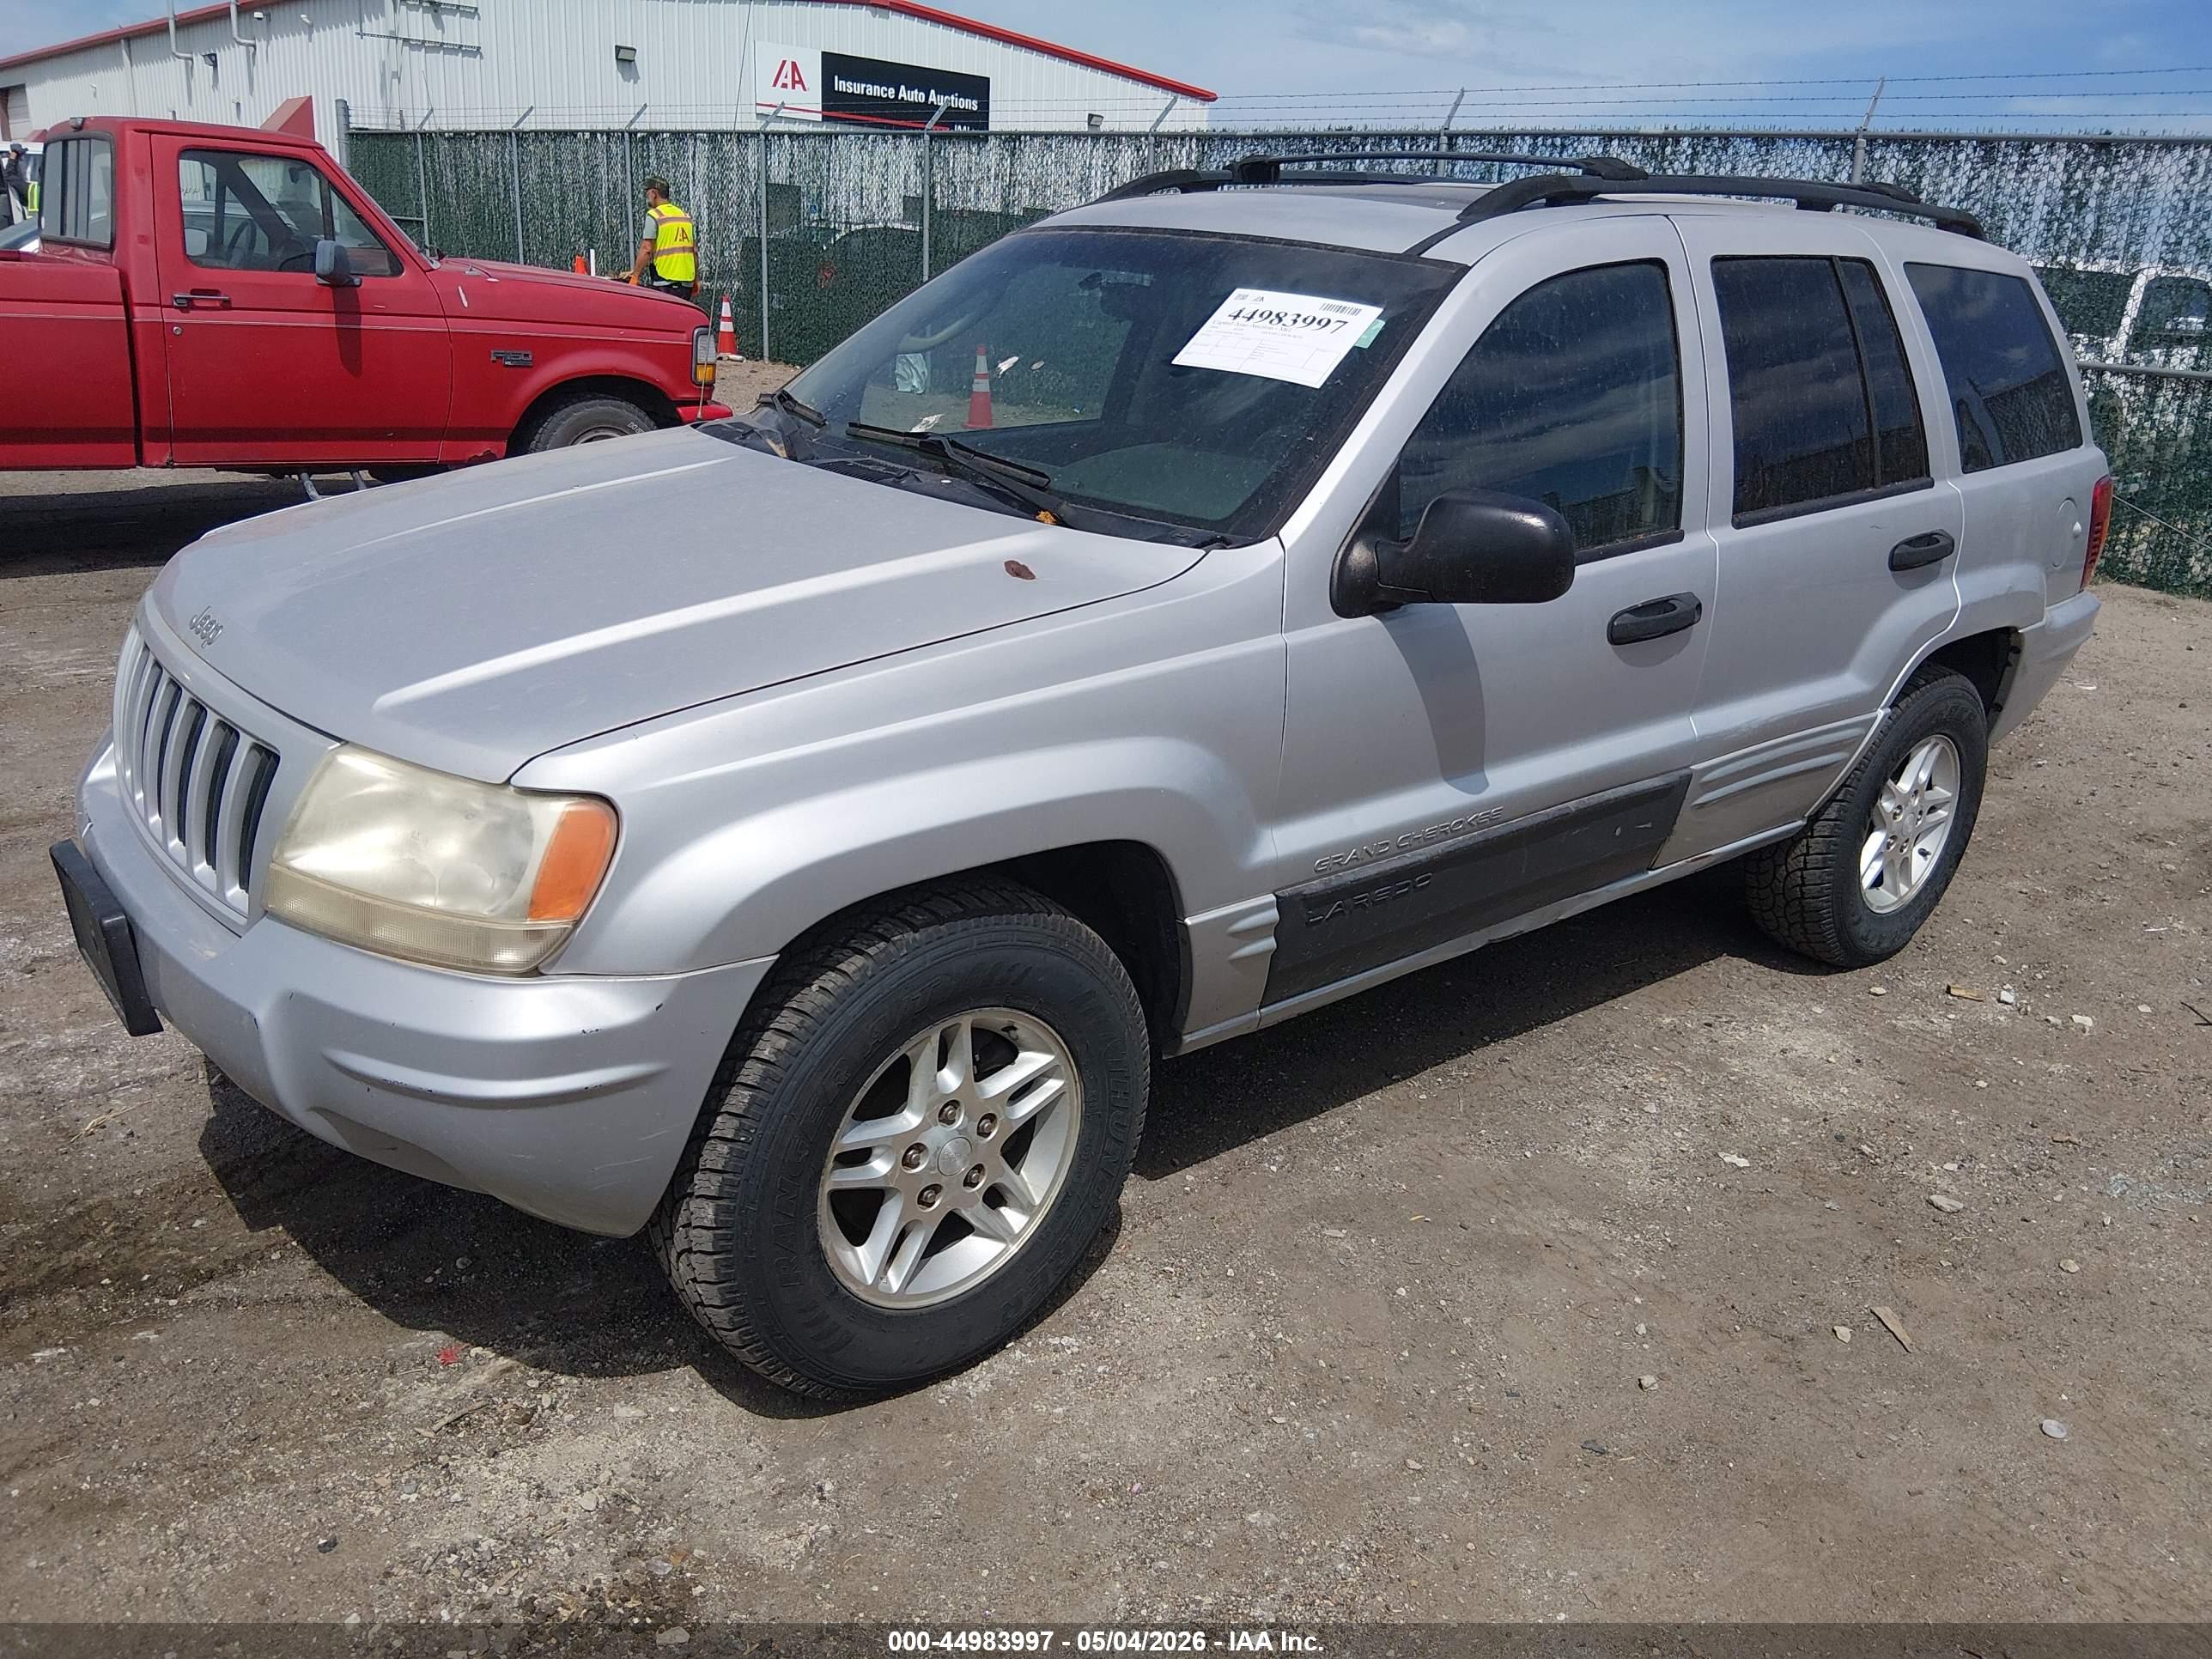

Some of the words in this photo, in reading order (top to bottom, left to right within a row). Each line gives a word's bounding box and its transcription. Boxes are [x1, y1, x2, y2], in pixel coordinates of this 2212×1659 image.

[834, 75, 895, 99] Insurance
[898, 85, 925, 103] Auto
[927, 89, 978, 111] Auctions
[1228, 307, 1348, 334] 44983997
[189, 605, 224, 649] Jeep
[1313, 839, 1389, 872] GRAND
[1396, 805, 1504, 848] CHEROKEE
[1306, 872, 1433, 924] LAREDO
